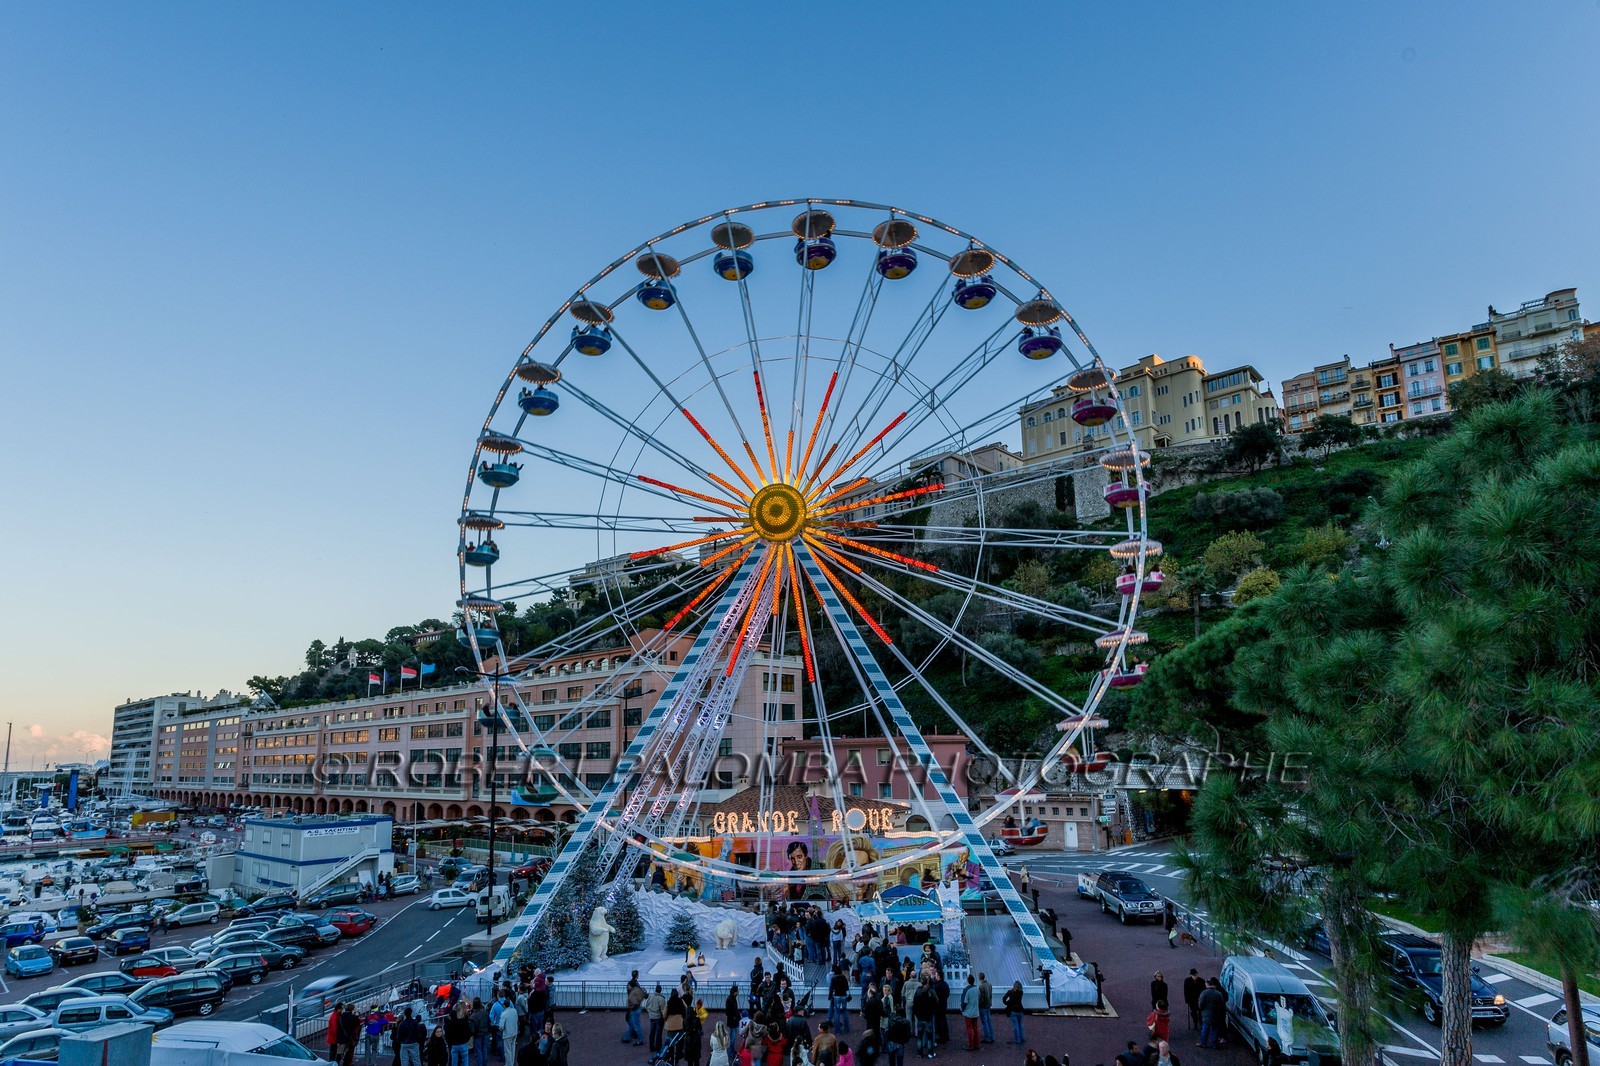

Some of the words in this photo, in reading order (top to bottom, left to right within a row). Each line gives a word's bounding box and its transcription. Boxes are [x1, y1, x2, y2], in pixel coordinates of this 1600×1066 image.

[713, 811, 800, 834] GRANDE
[831, 808, 894, 832] ROUE
[898, 897, 927, 907] CAISSE
